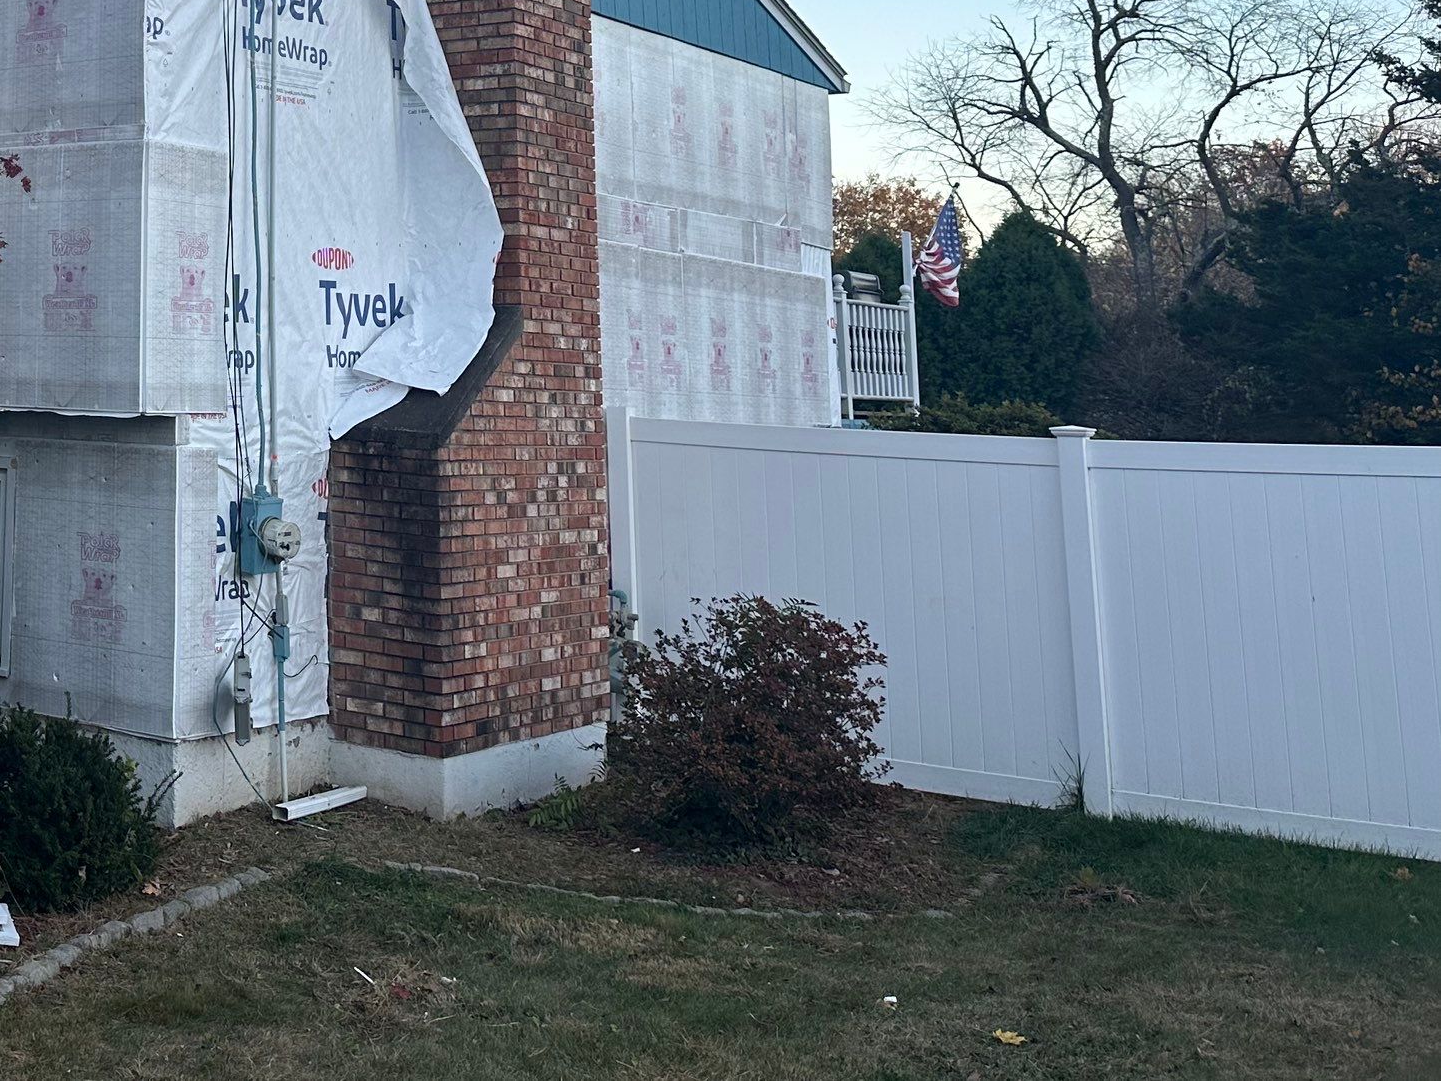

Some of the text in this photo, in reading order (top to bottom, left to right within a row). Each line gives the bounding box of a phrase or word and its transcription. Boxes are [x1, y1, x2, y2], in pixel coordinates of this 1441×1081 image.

[242, 26, 328, 70] HomeWrap
[312, 247, 355, 271] DUPONT
[319, 279, 404, 339] Tyvek
